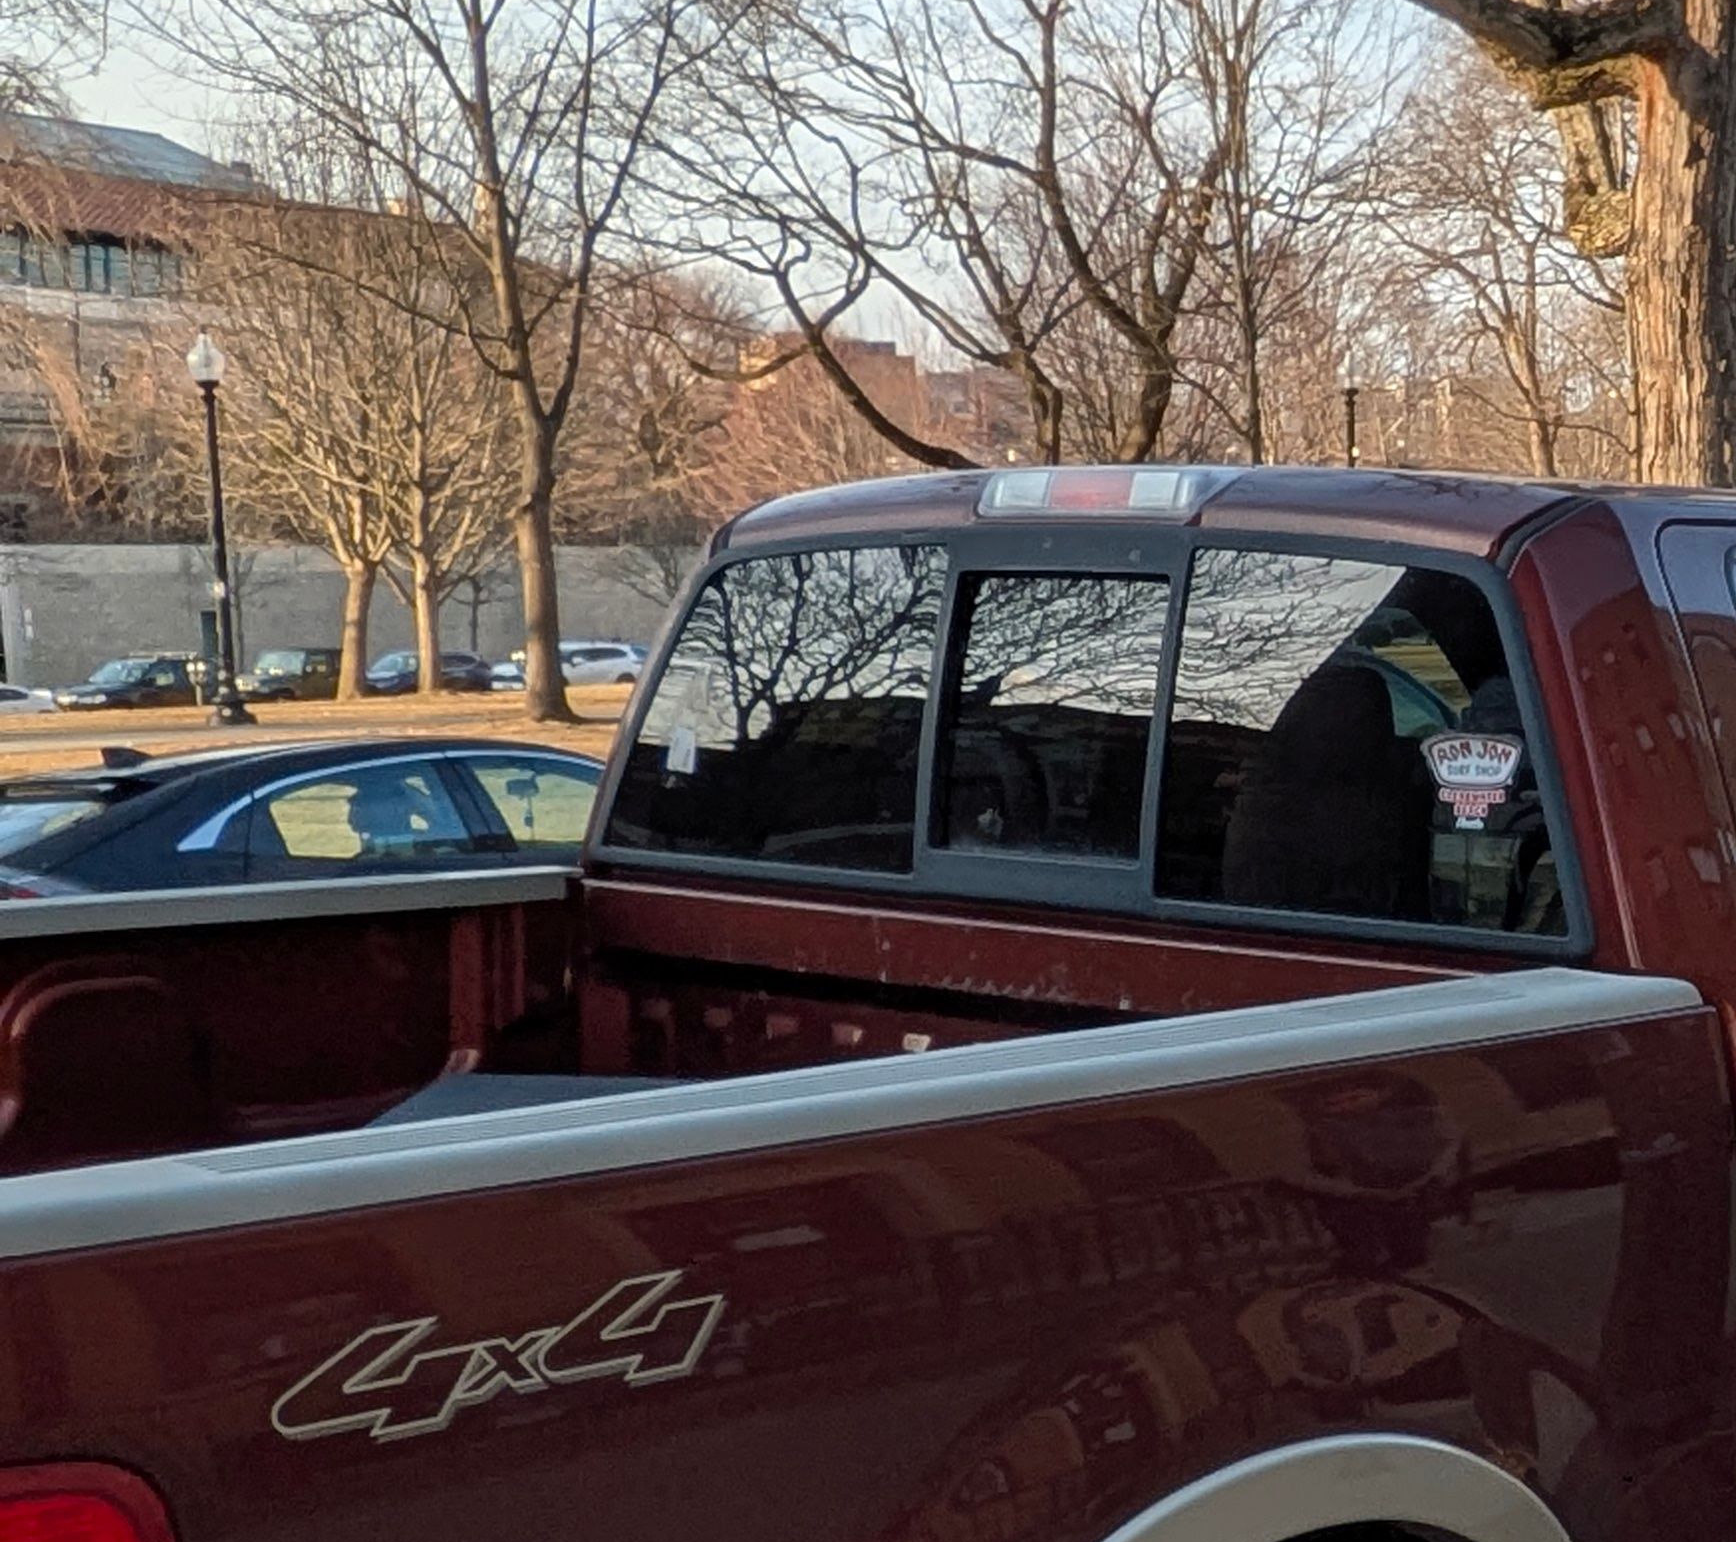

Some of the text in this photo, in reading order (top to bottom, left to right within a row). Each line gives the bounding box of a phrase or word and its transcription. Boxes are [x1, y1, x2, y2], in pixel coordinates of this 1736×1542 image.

[1436, 740, 1512, 765] RON JON
[1447, 764, 1502, 777] SURF SHOP
[272, 1270, 727, 1442] 4x4
